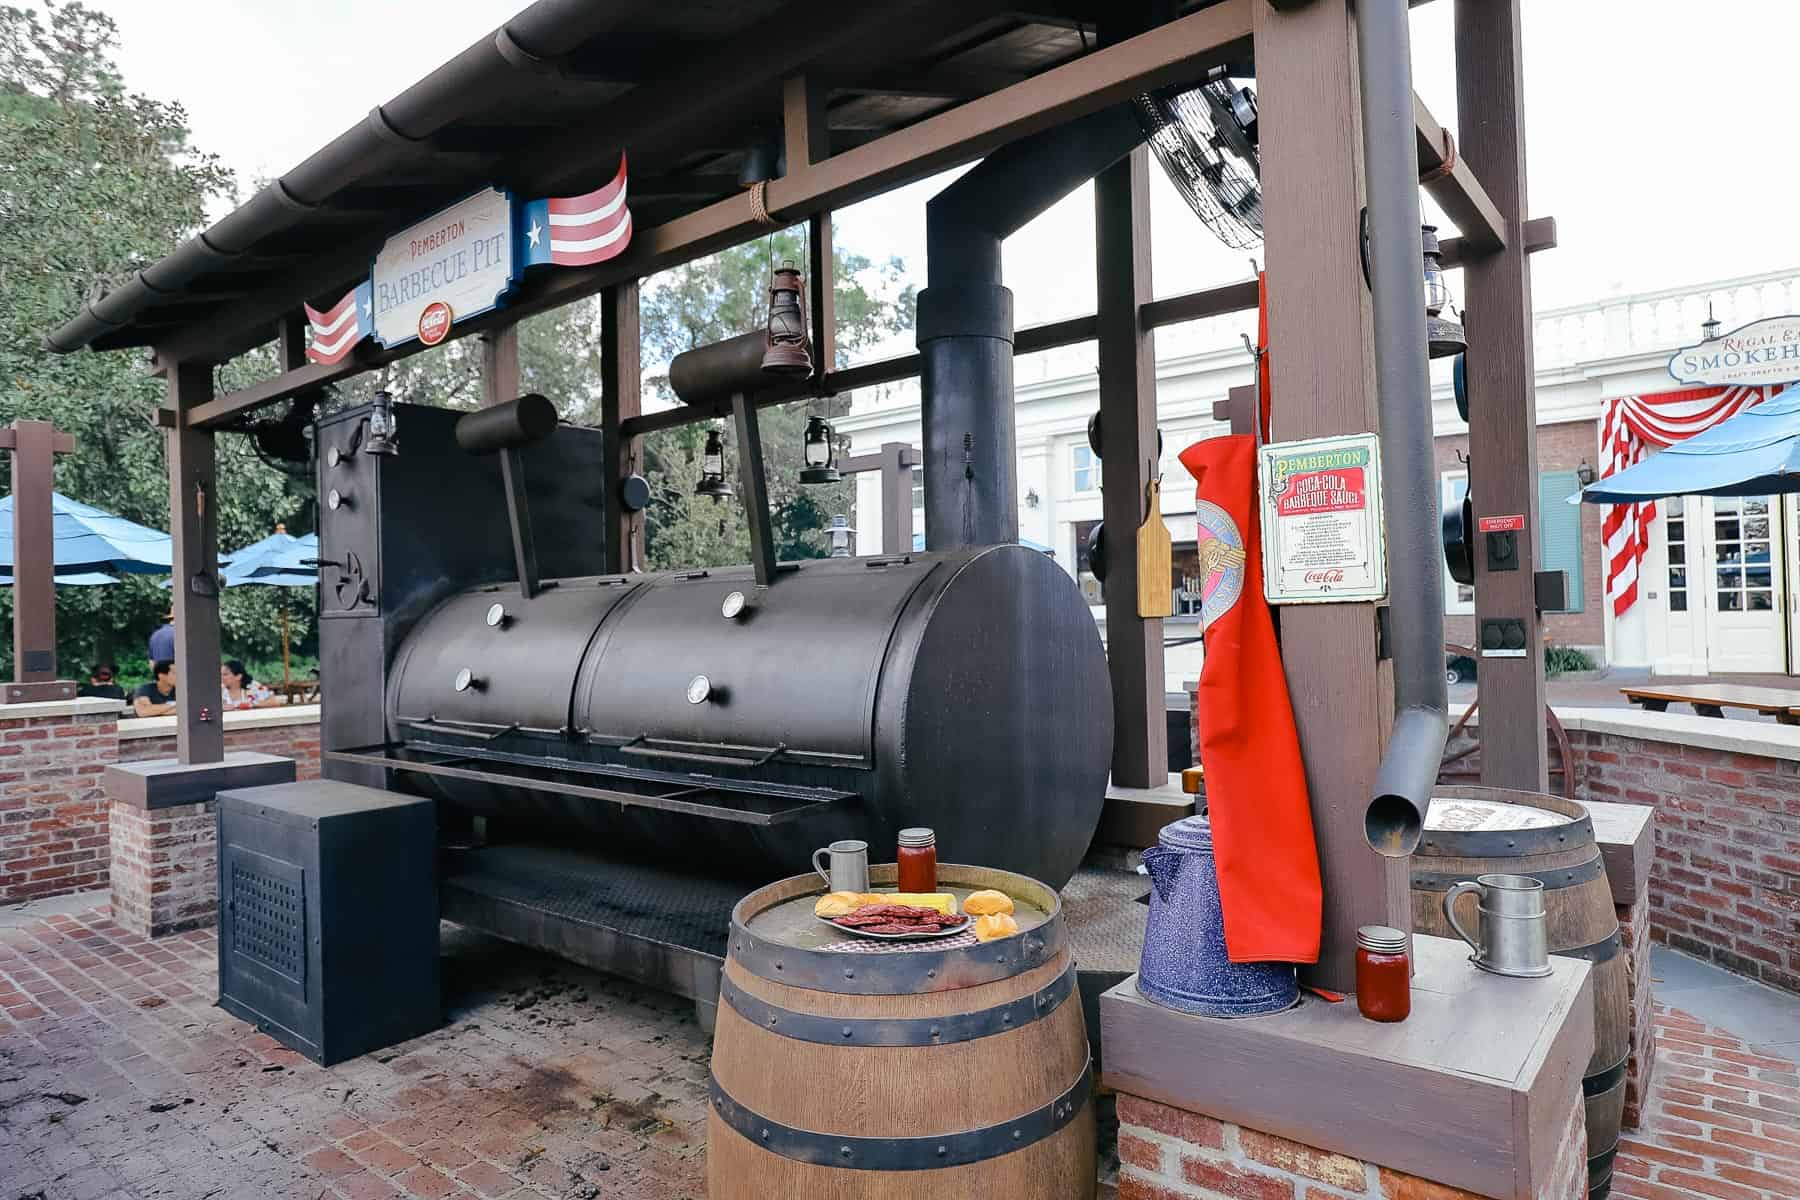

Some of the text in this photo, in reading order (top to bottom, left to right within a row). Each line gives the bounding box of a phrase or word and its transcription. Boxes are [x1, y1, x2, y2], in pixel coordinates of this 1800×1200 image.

[408, 218, 465, 262] PEMBERTON
[378, 232, 505, 313] BARBECUE PIT
[1275, 450, 1361, 481] PEMBERTON
[1296, 474, 1347, 495] COCA-COLA
[1283, 490, 1329, 510] BARBEQUE
[1330, 491, 1359, 505] SAUCE
[1304, 568, 1344, 584] Coca-Cola
